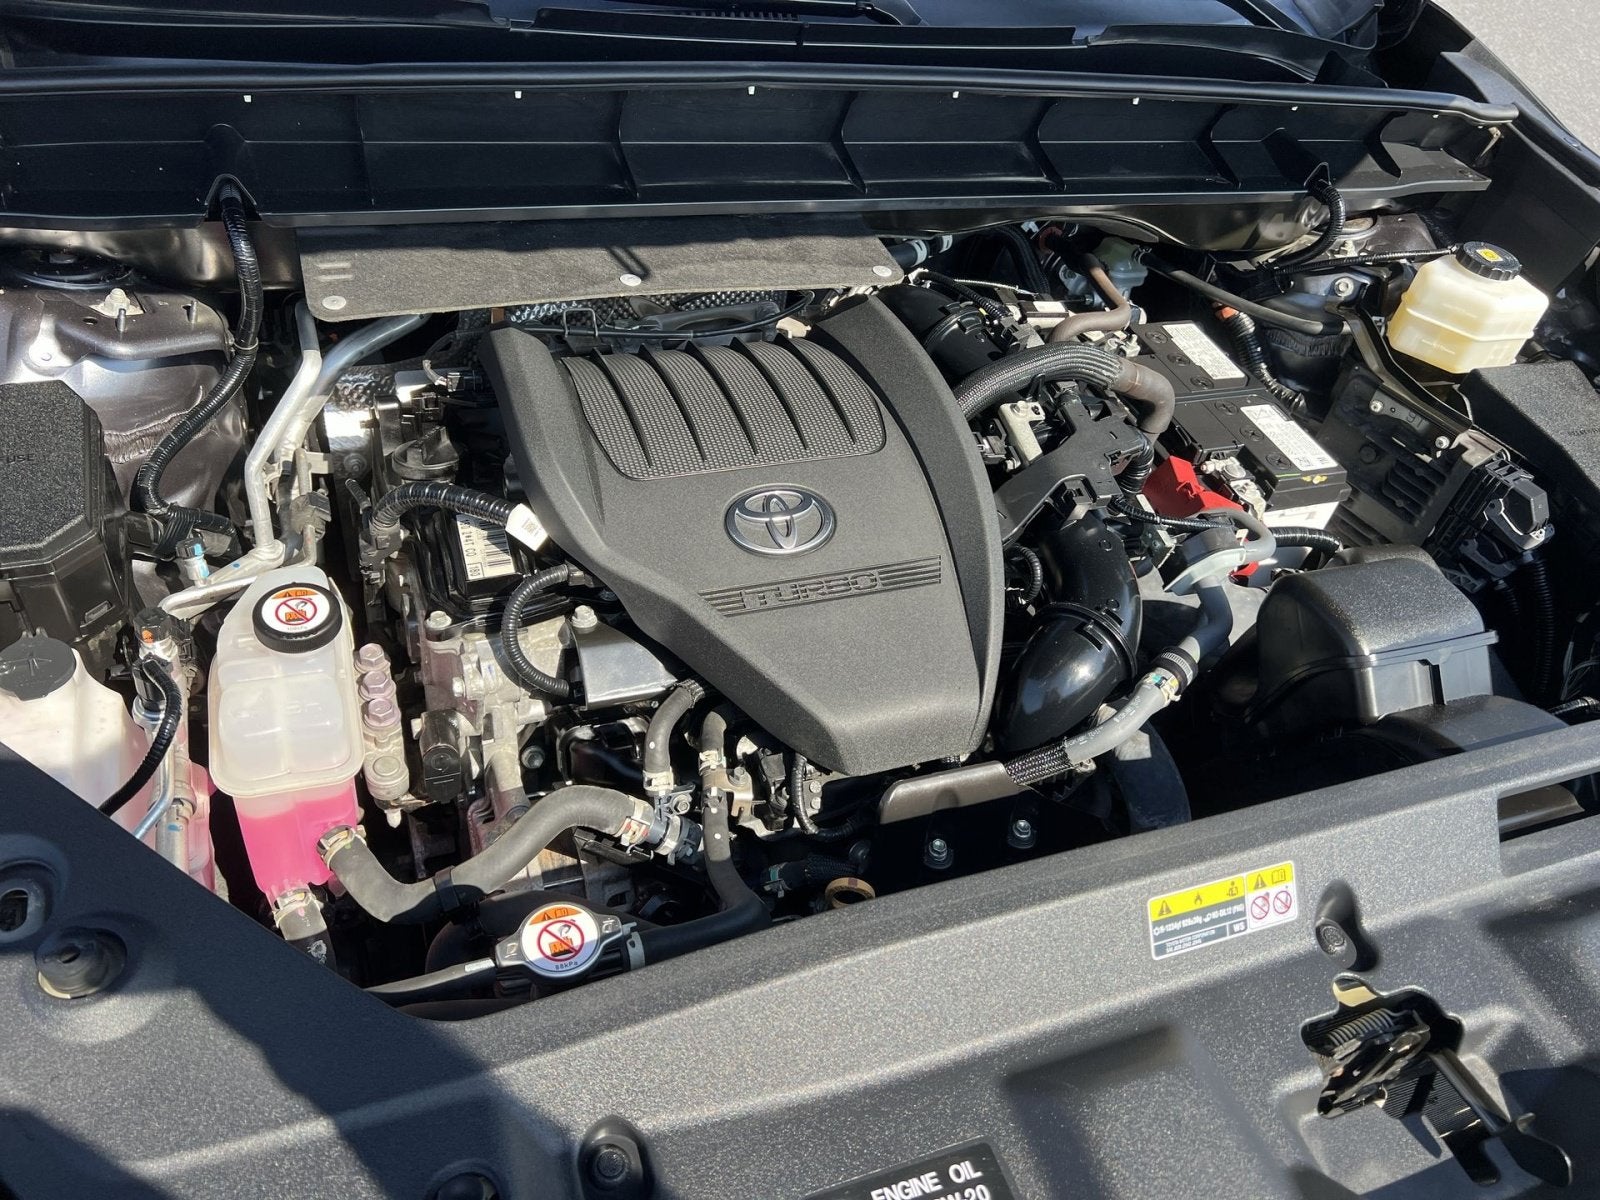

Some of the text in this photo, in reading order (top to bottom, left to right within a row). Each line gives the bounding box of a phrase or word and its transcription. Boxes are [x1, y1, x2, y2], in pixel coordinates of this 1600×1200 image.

[740, 572, 877, 607] TURBO
[870, 1160, 983, 1200] ENGINE OIL
